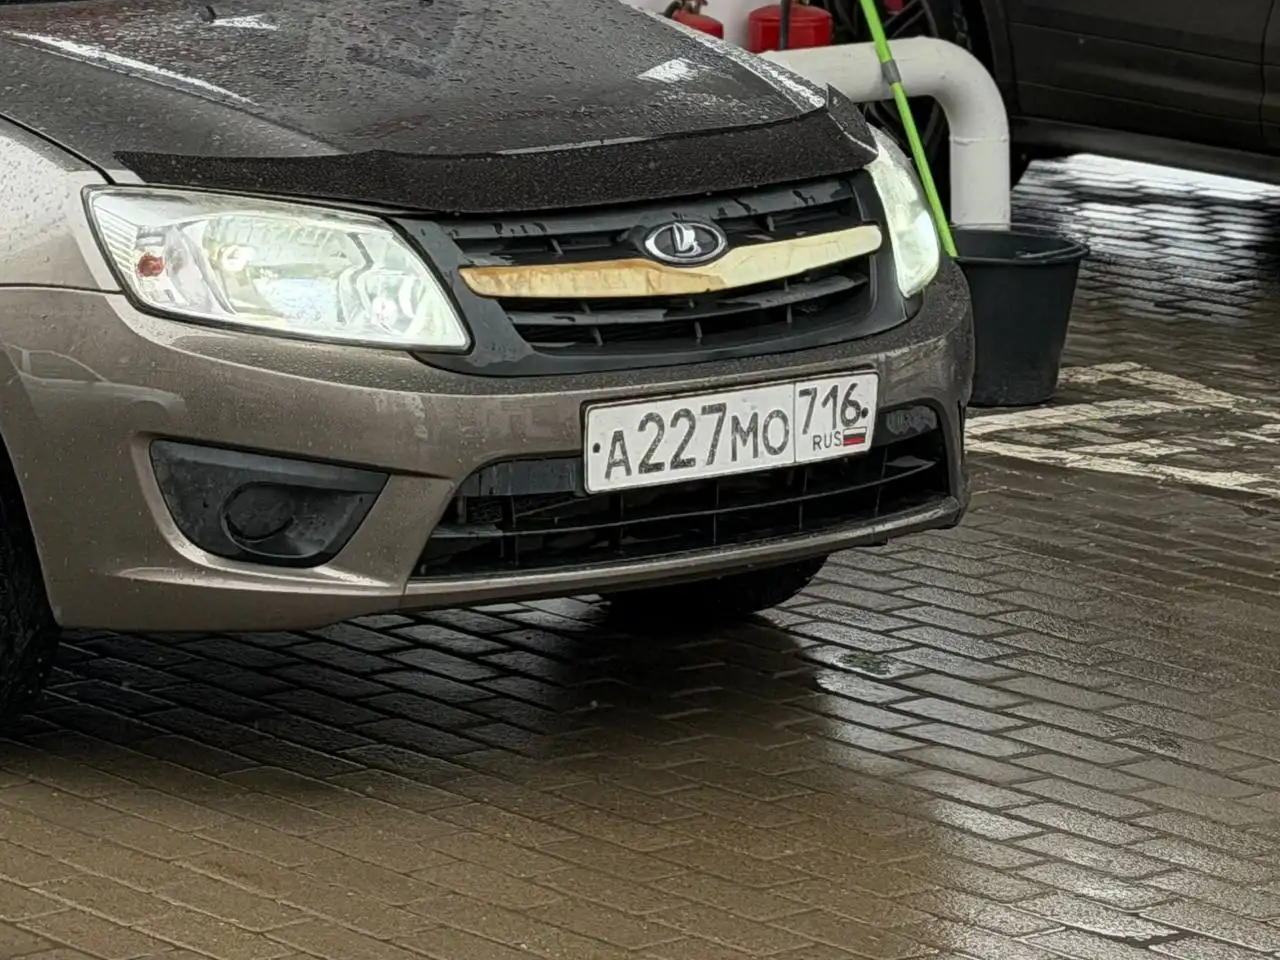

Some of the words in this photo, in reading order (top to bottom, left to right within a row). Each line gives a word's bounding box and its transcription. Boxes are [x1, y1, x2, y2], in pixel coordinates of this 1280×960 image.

[604, 402, 790, 480] А227МО
[798, 382, 862, 435] 716
[812, 430, 841, 451] RUS
